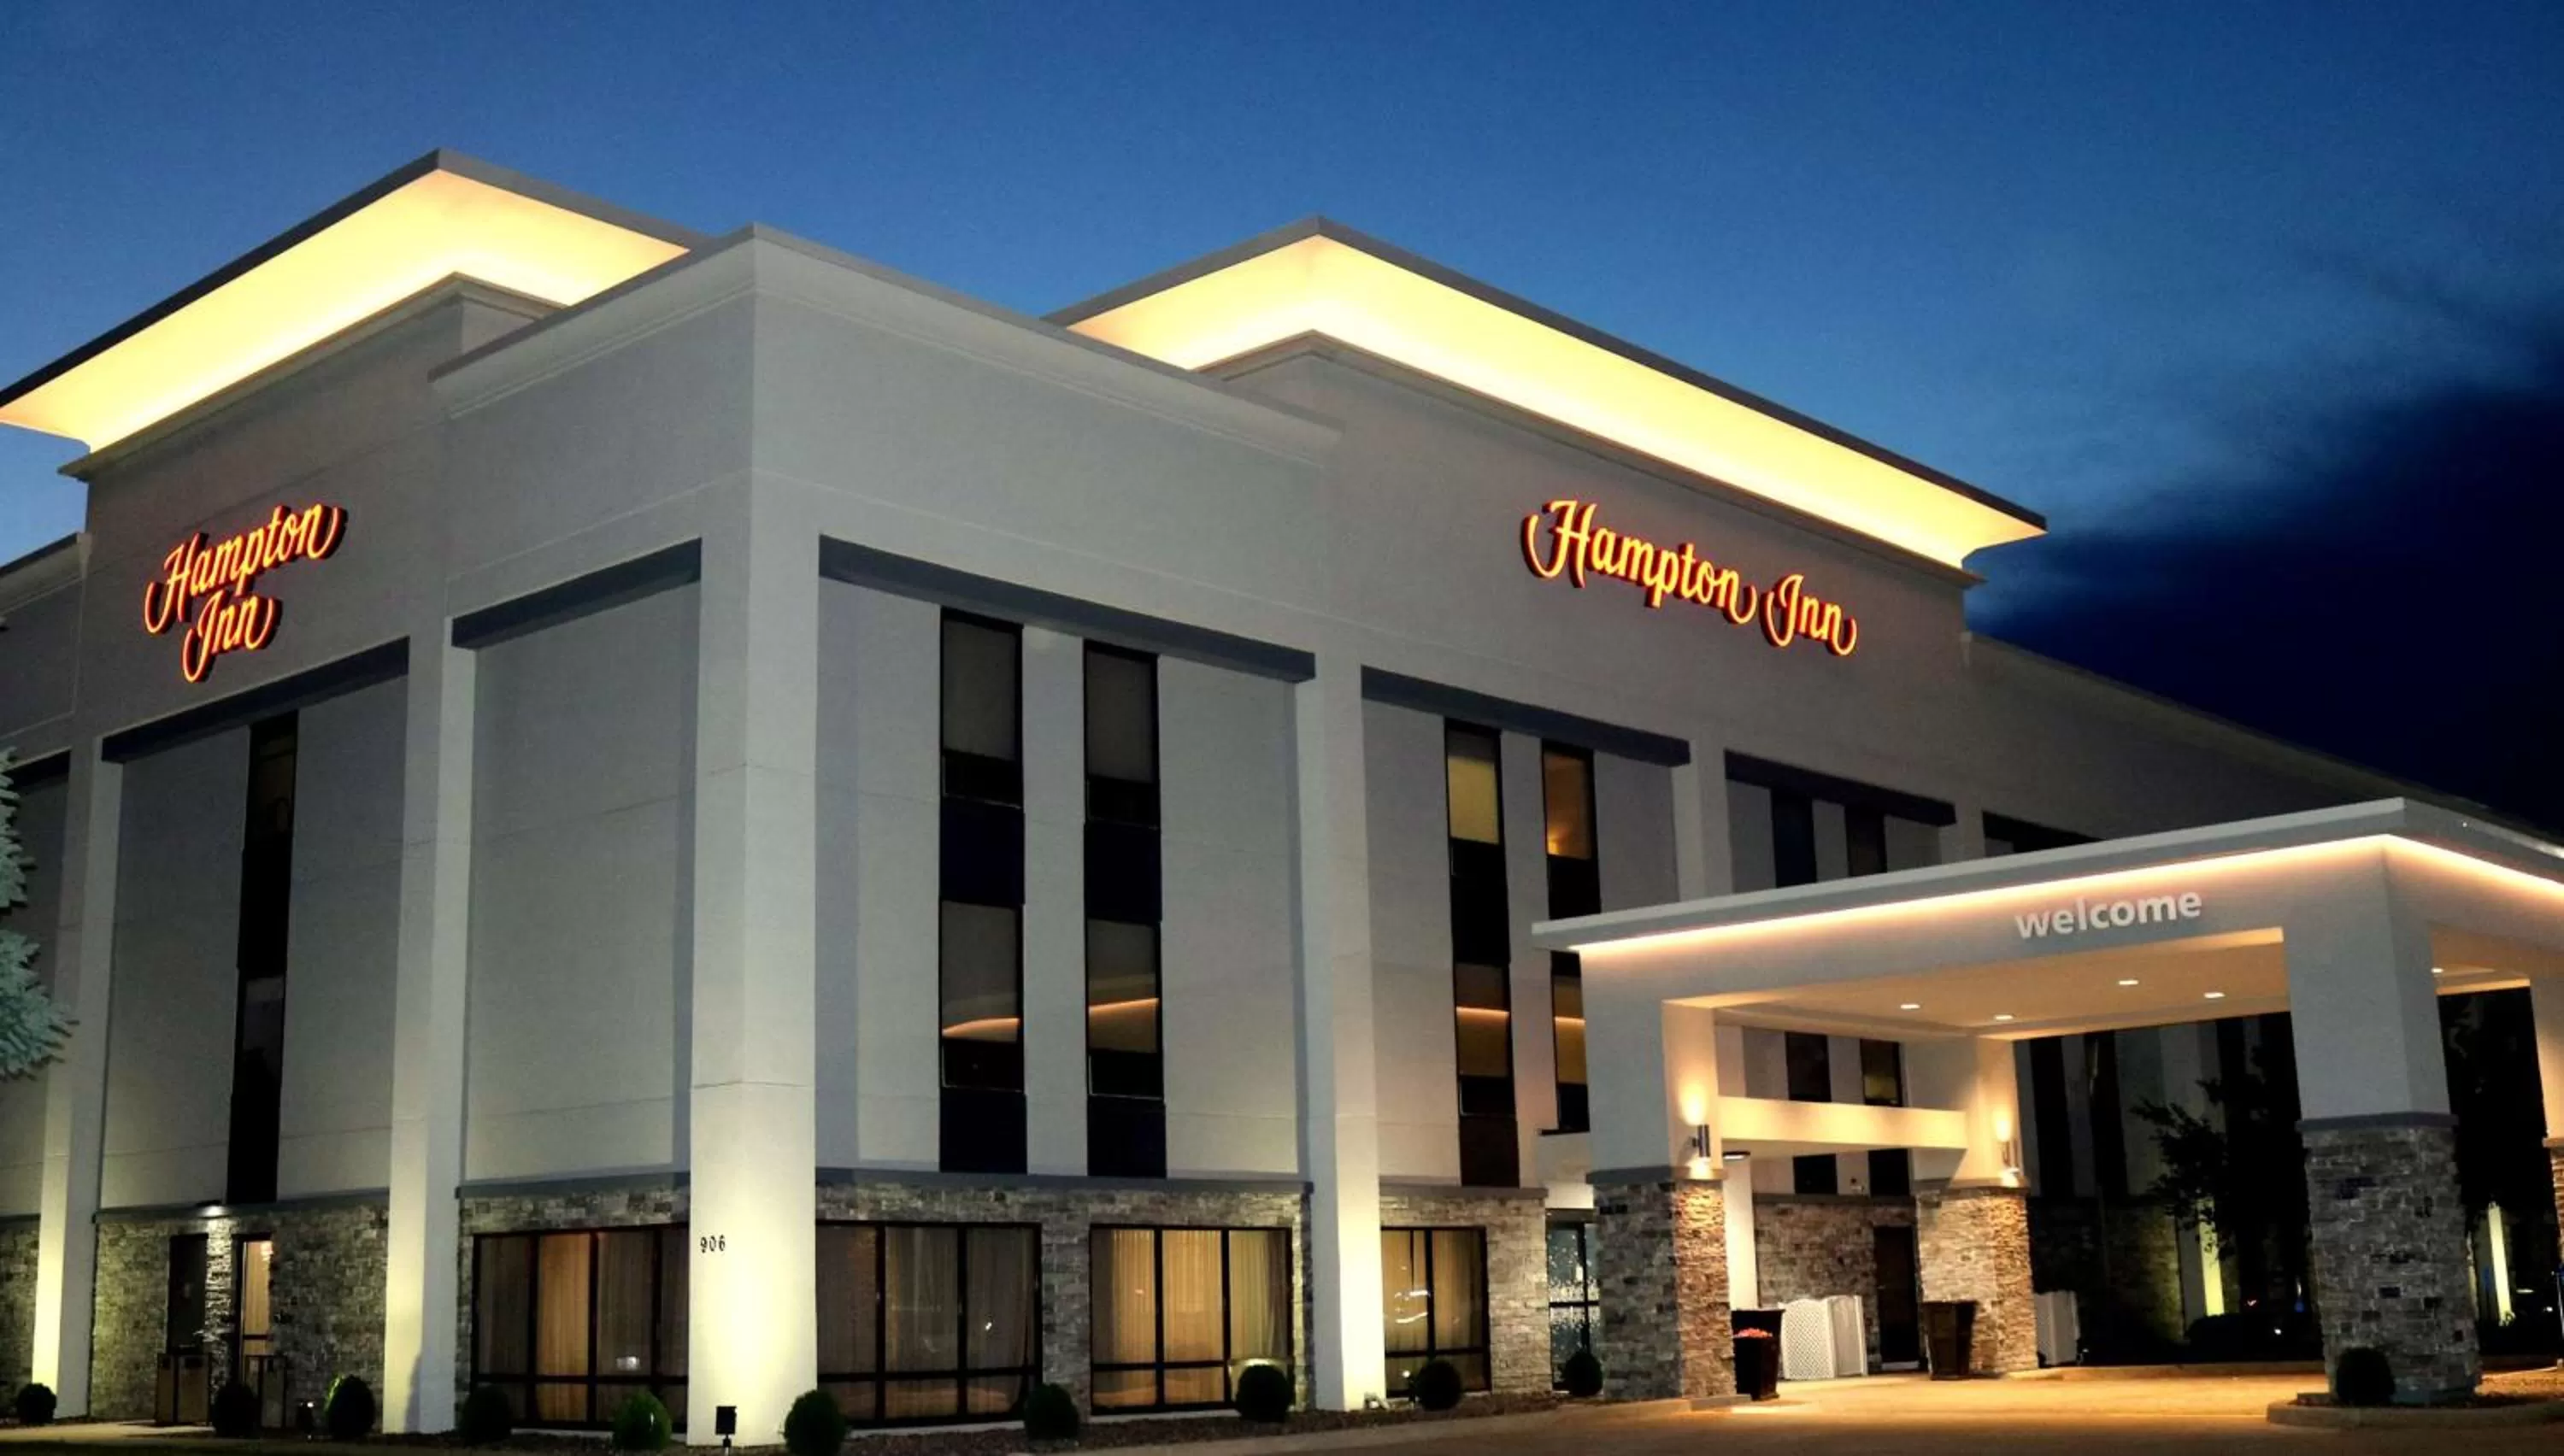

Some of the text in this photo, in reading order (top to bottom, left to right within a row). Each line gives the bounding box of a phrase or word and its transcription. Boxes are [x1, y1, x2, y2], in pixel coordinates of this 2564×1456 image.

[144, 502, 348, 633] Hampton
[1520, 499, 1857, 656] Hampton Inn
[182, 589, 283, 683] Inn
[2014, 891, 2202, 939] welcome
[700, 1234, 726, 1254] 906
